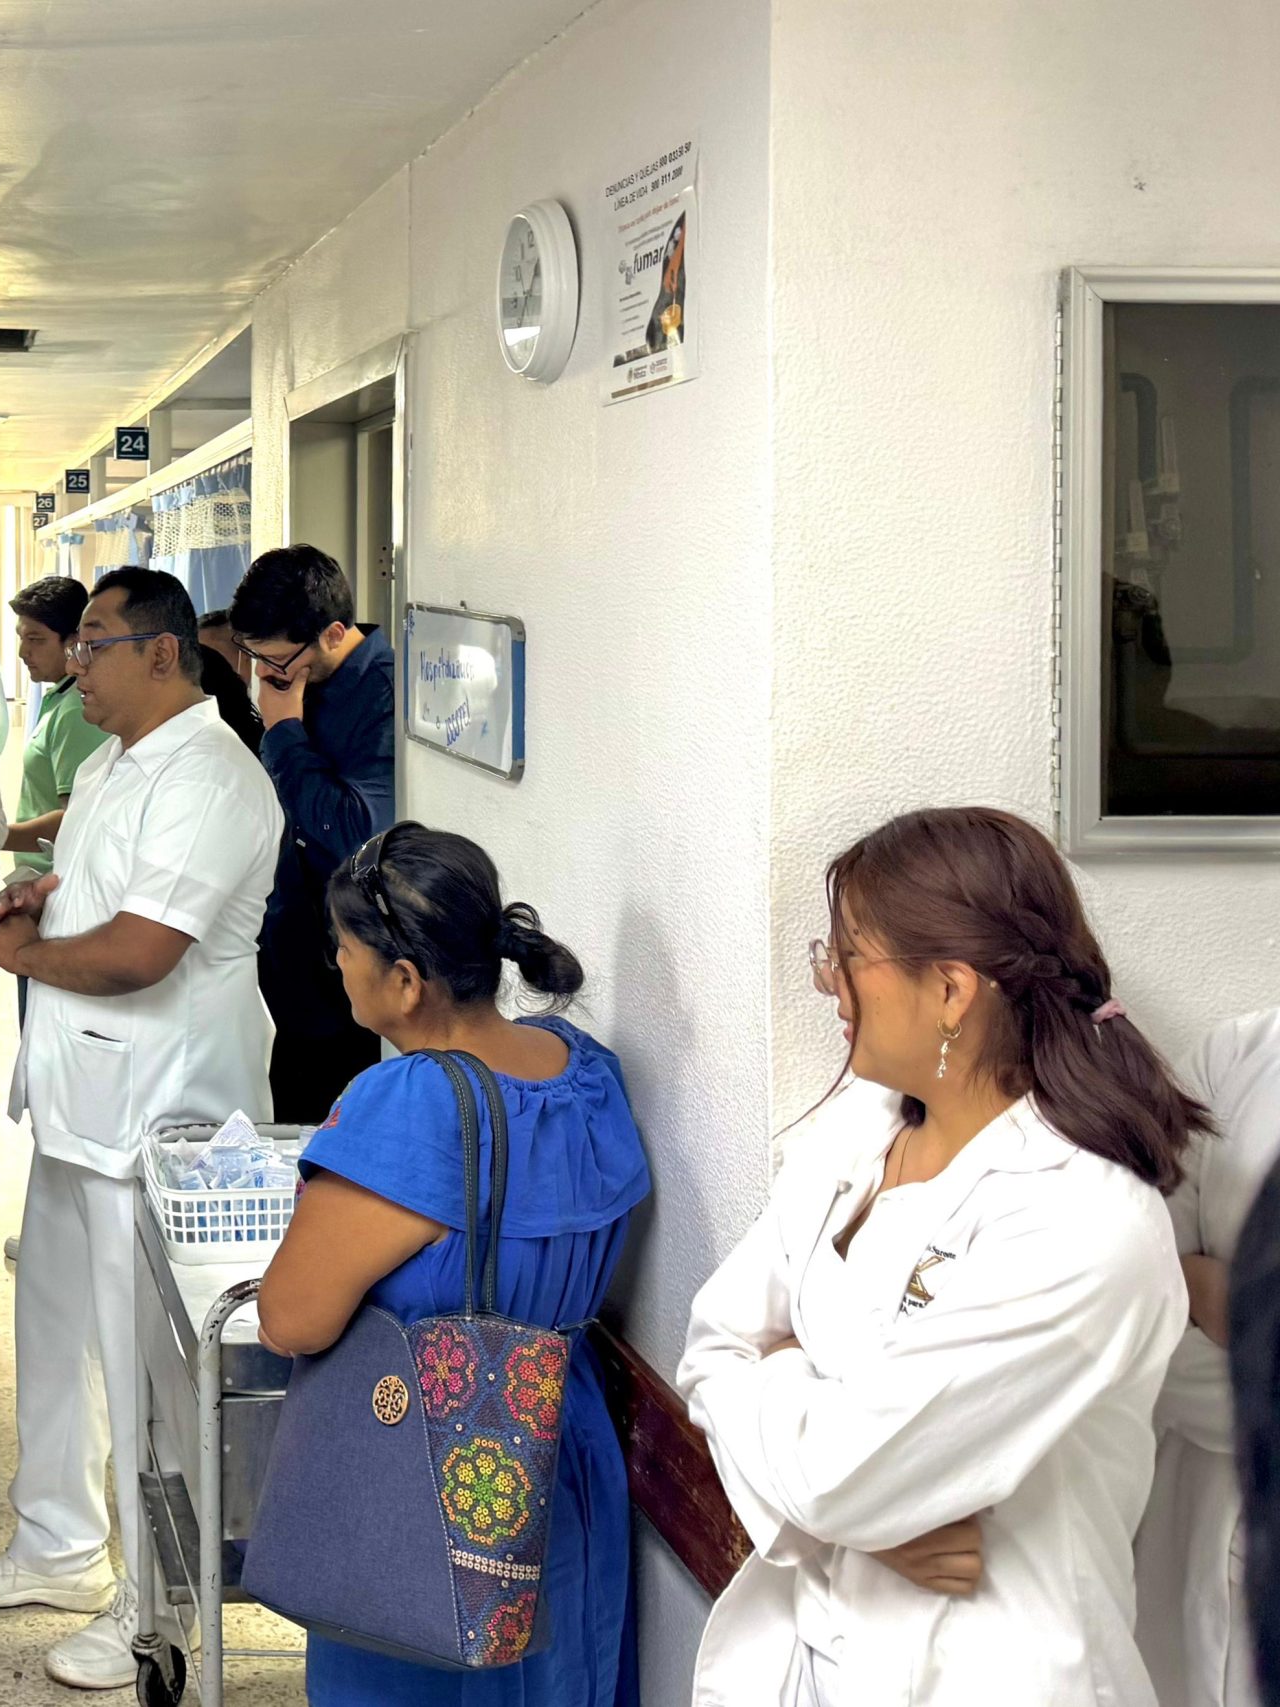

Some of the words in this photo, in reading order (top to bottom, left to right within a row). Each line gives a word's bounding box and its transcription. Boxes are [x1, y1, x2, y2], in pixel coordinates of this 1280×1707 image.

[605, 174, 635, 198] DENUNCIAS
[639, 161, 658, 180] QUEJAS
[633, 246, 664, 274] fumar
[120, 436, 145, 452] 24
[68, 475, 87, 488] 25
[37, 498, 52, 508] 26
[33, 516, 46, 527] 27
